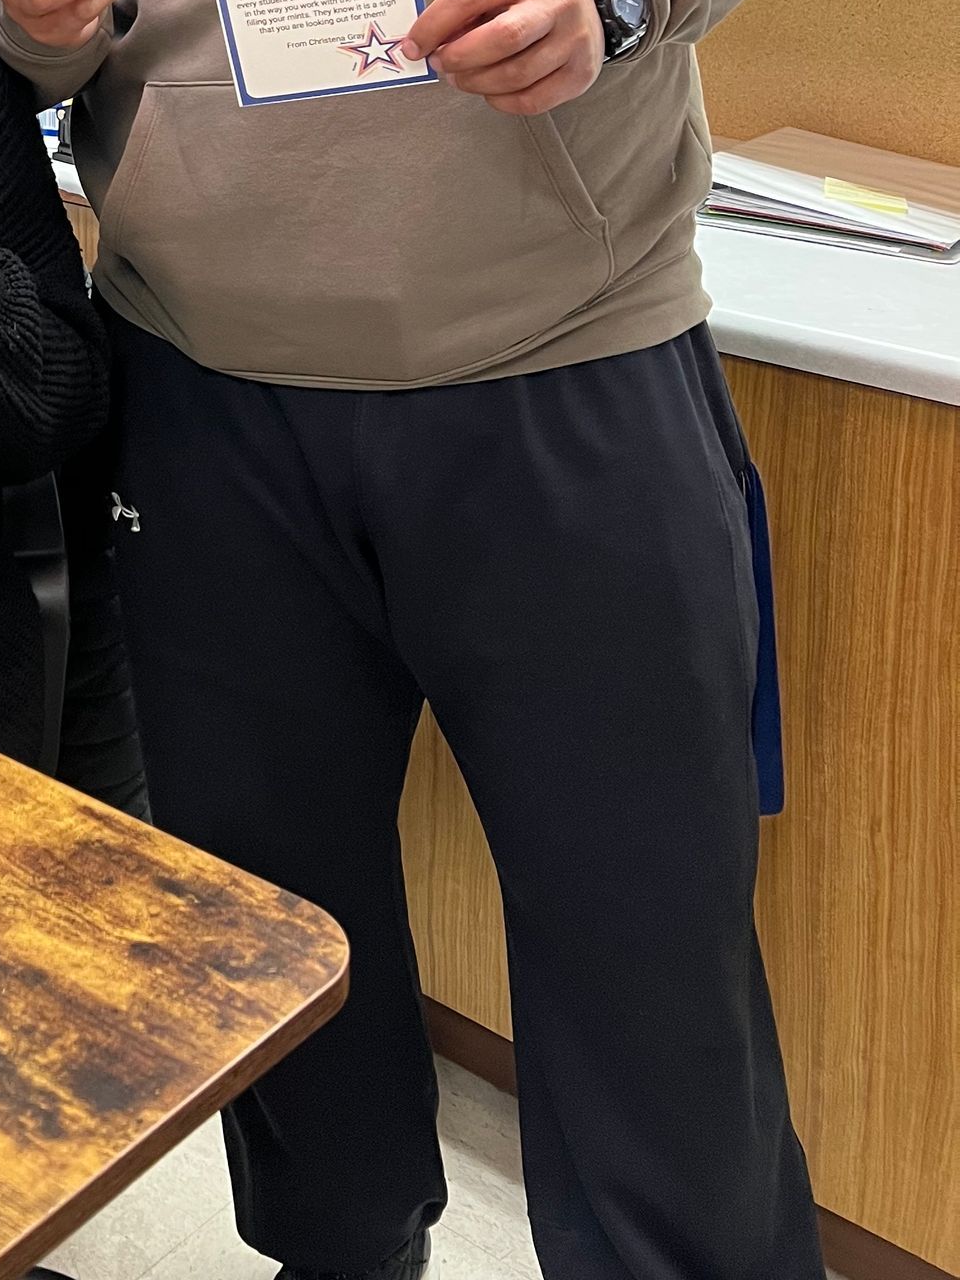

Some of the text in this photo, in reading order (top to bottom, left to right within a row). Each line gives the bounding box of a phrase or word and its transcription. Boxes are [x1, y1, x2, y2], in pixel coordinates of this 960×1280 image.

[236, 0, 257, 9] every
[252, 8, 266, 16] the
[266, 7, 282, 15] way
[284, 4, 299, 13] you
[299, 0, 319, 9] work
[246, 18, 267, 26] filling
[268, 15, 285, 25] your
[312, 7, 331, 17] They
[332, 6, 354, 14] know
[379, 0, 396, 7] sign
[259, 26, 275, 34] that
[275, 24, 290, 33] you
[305, 18, 334, 27] looking
[335, 15, 349, 23] out
[350, 13, 362, 21] for
[363, 9, 386, 19] them!
[346, 30, 365, 40] Gray
